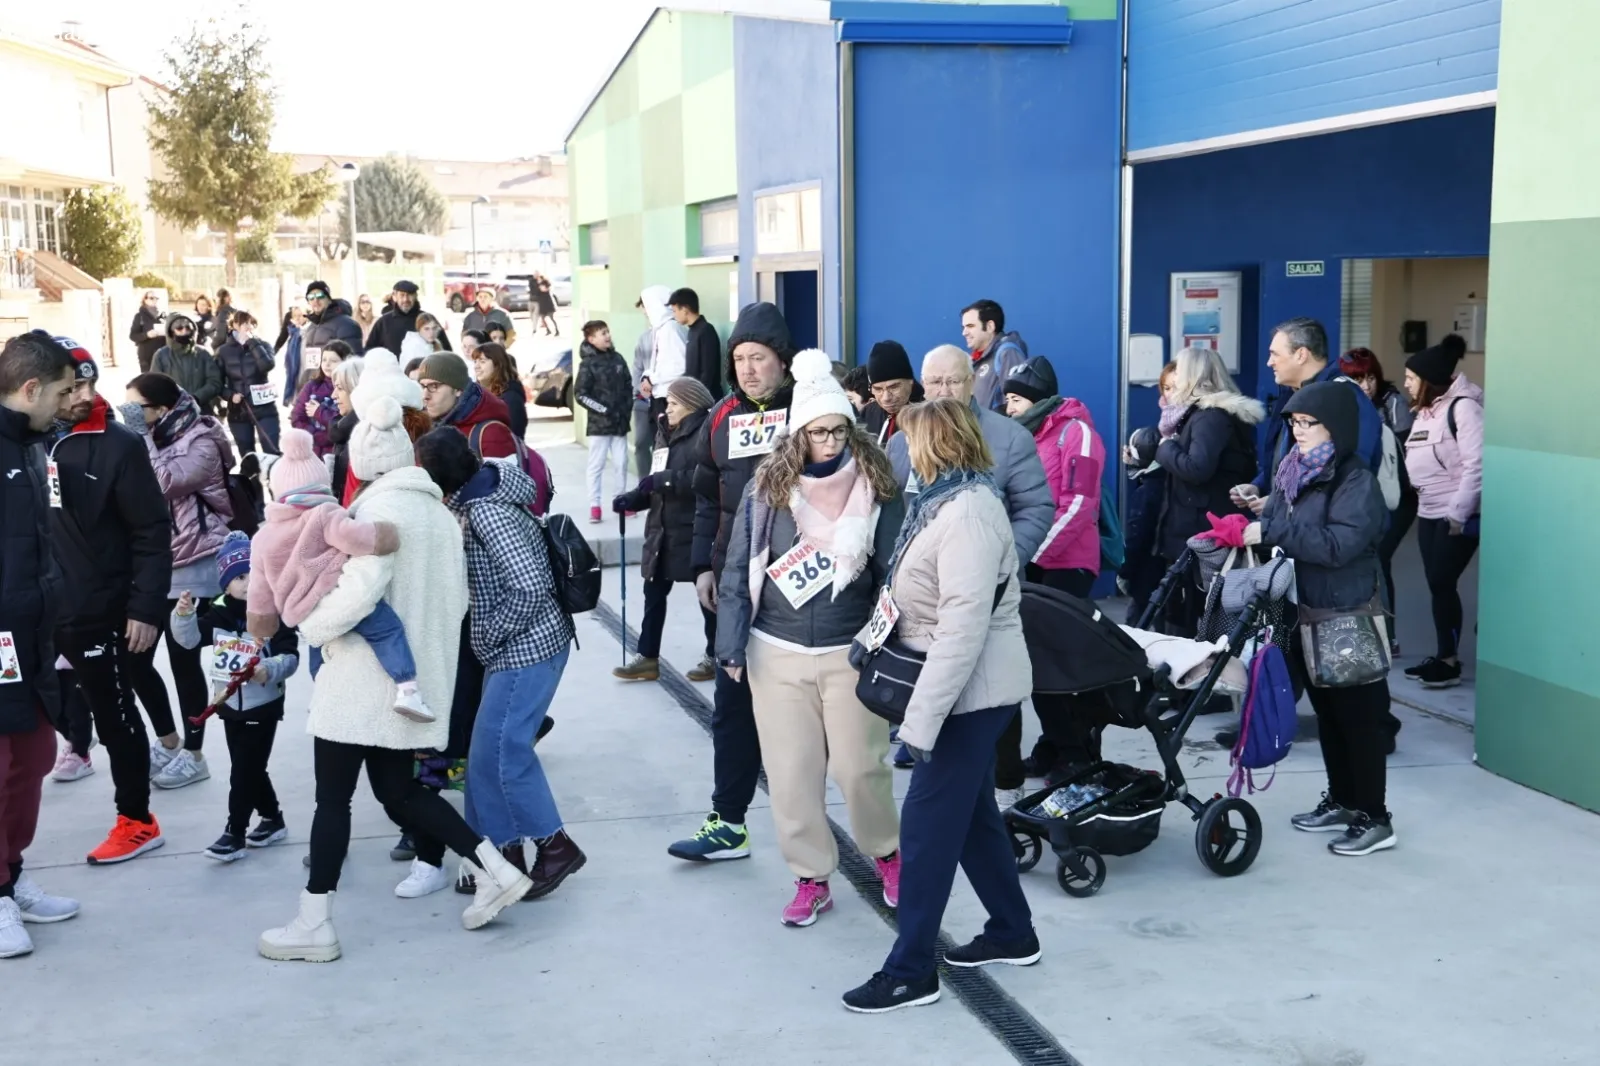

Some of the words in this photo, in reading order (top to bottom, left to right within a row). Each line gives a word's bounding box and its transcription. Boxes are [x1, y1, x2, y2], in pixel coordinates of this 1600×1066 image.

[1289, 264, 1322, 273] SALIDA
[730, 412, 785, 429] benia
[739, 425, 776, 447] 367
[768, 543, 816, 580] bedun
[788, 550, 832, 590] 366
[214, 651, 250, 672] 36
